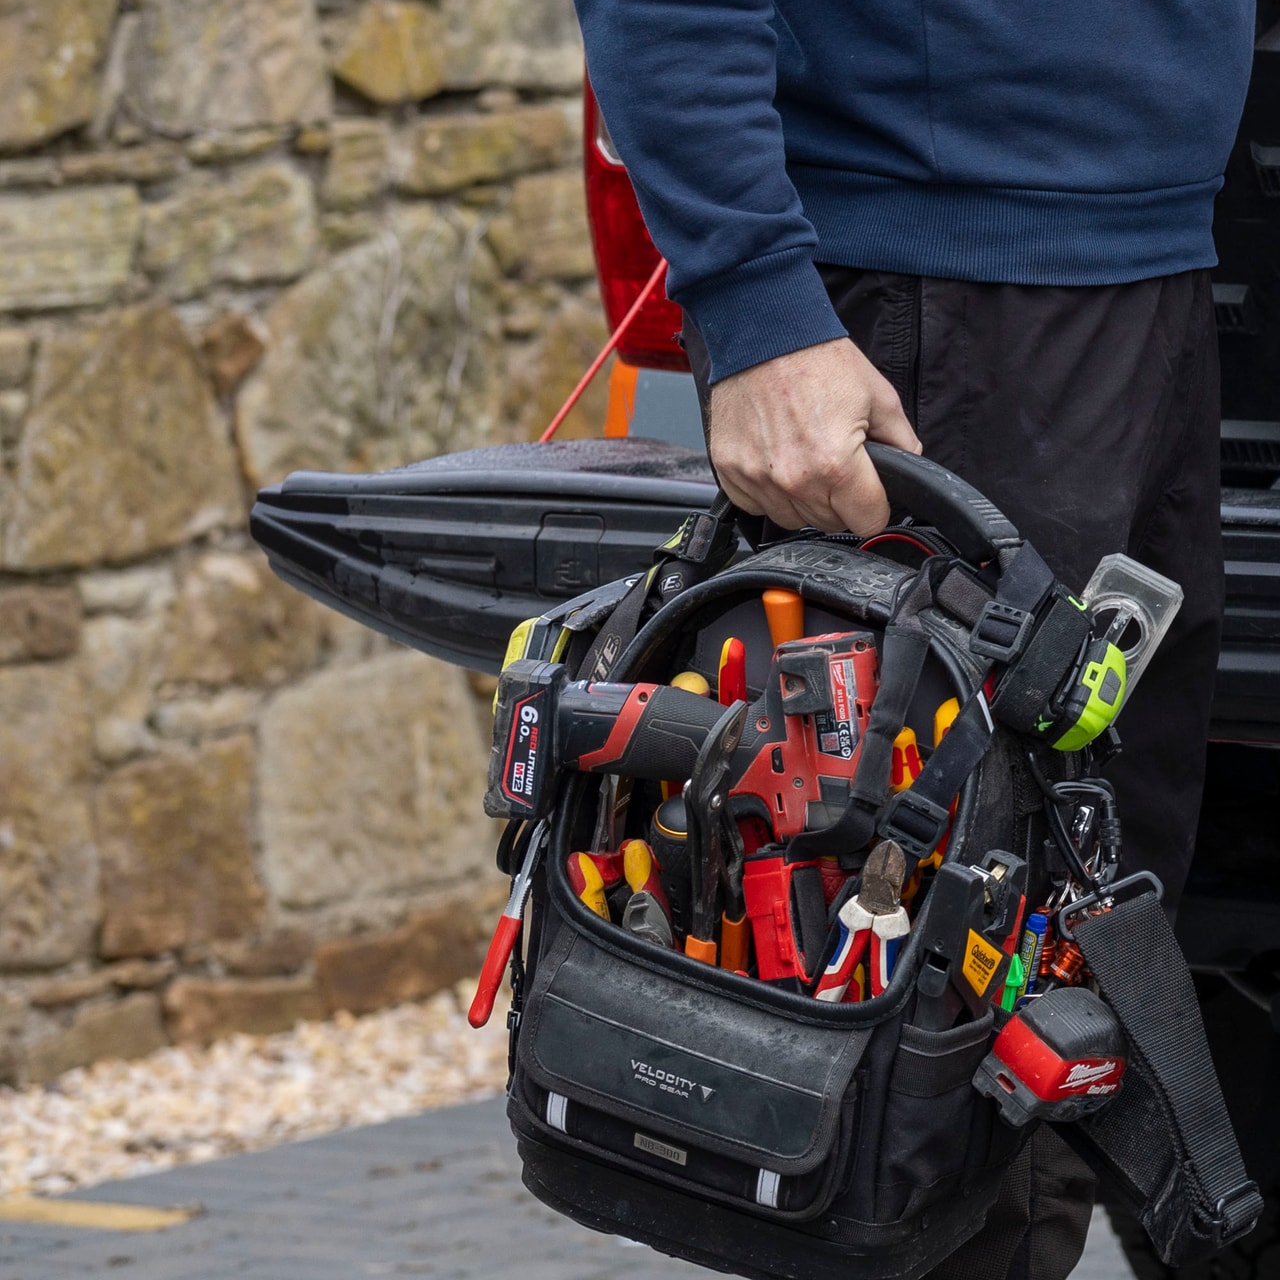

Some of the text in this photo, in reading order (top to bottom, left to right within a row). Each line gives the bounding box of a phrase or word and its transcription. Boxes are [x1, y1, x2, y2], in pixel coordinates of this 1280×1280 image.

[525, 726, 539, 796] REDLITHIUM
[512, 763, 525, 792] M12
[630, 1058, 697, 1091] VELOCITY
[634, 1073, 690, 1099] PRO GEAR
[639, 1138, 681, 1160] NB-300
